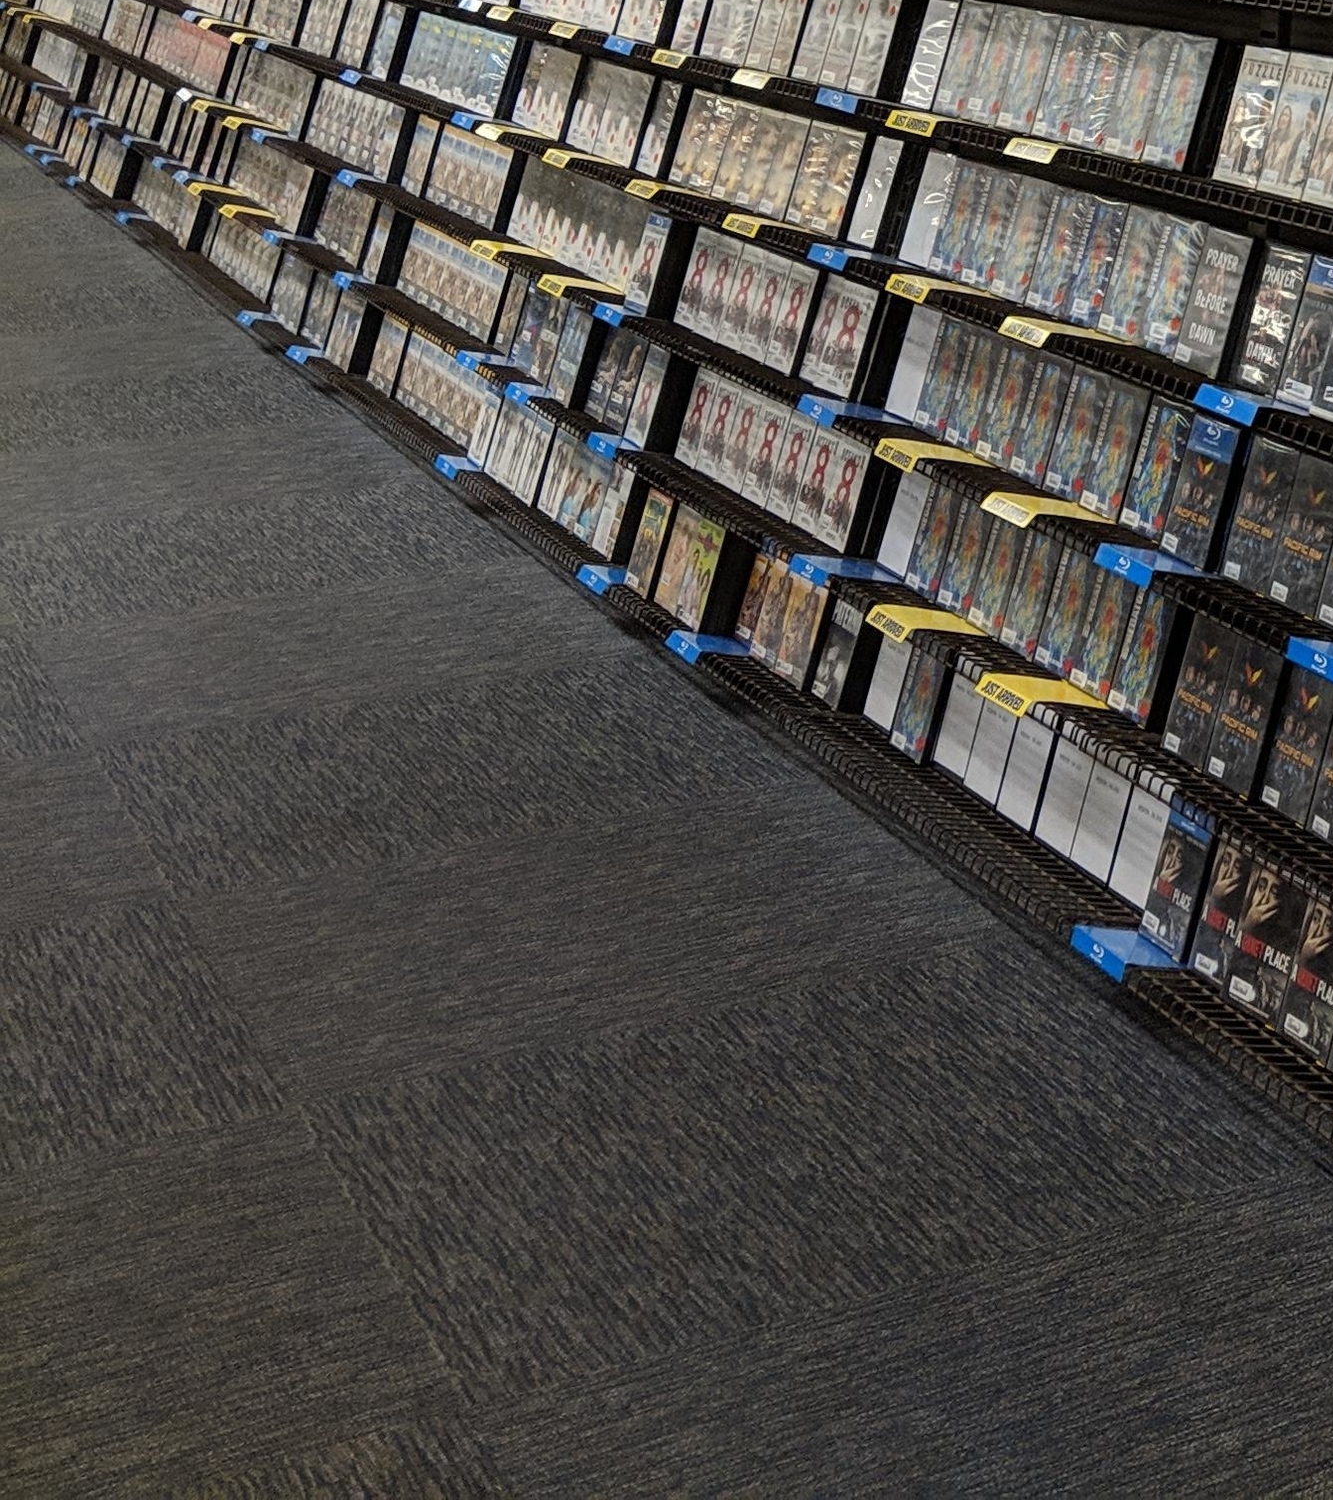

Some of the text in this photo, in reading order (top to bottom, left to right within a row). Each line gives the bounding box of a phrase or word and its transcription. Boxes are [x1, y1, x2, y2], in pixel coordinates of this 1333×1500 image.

[1242, 62, 1283, 81] PUZZLE
[1206, 250, 1239, 270] PRAYER
[1188, 323, 1216, 345] DAWN
